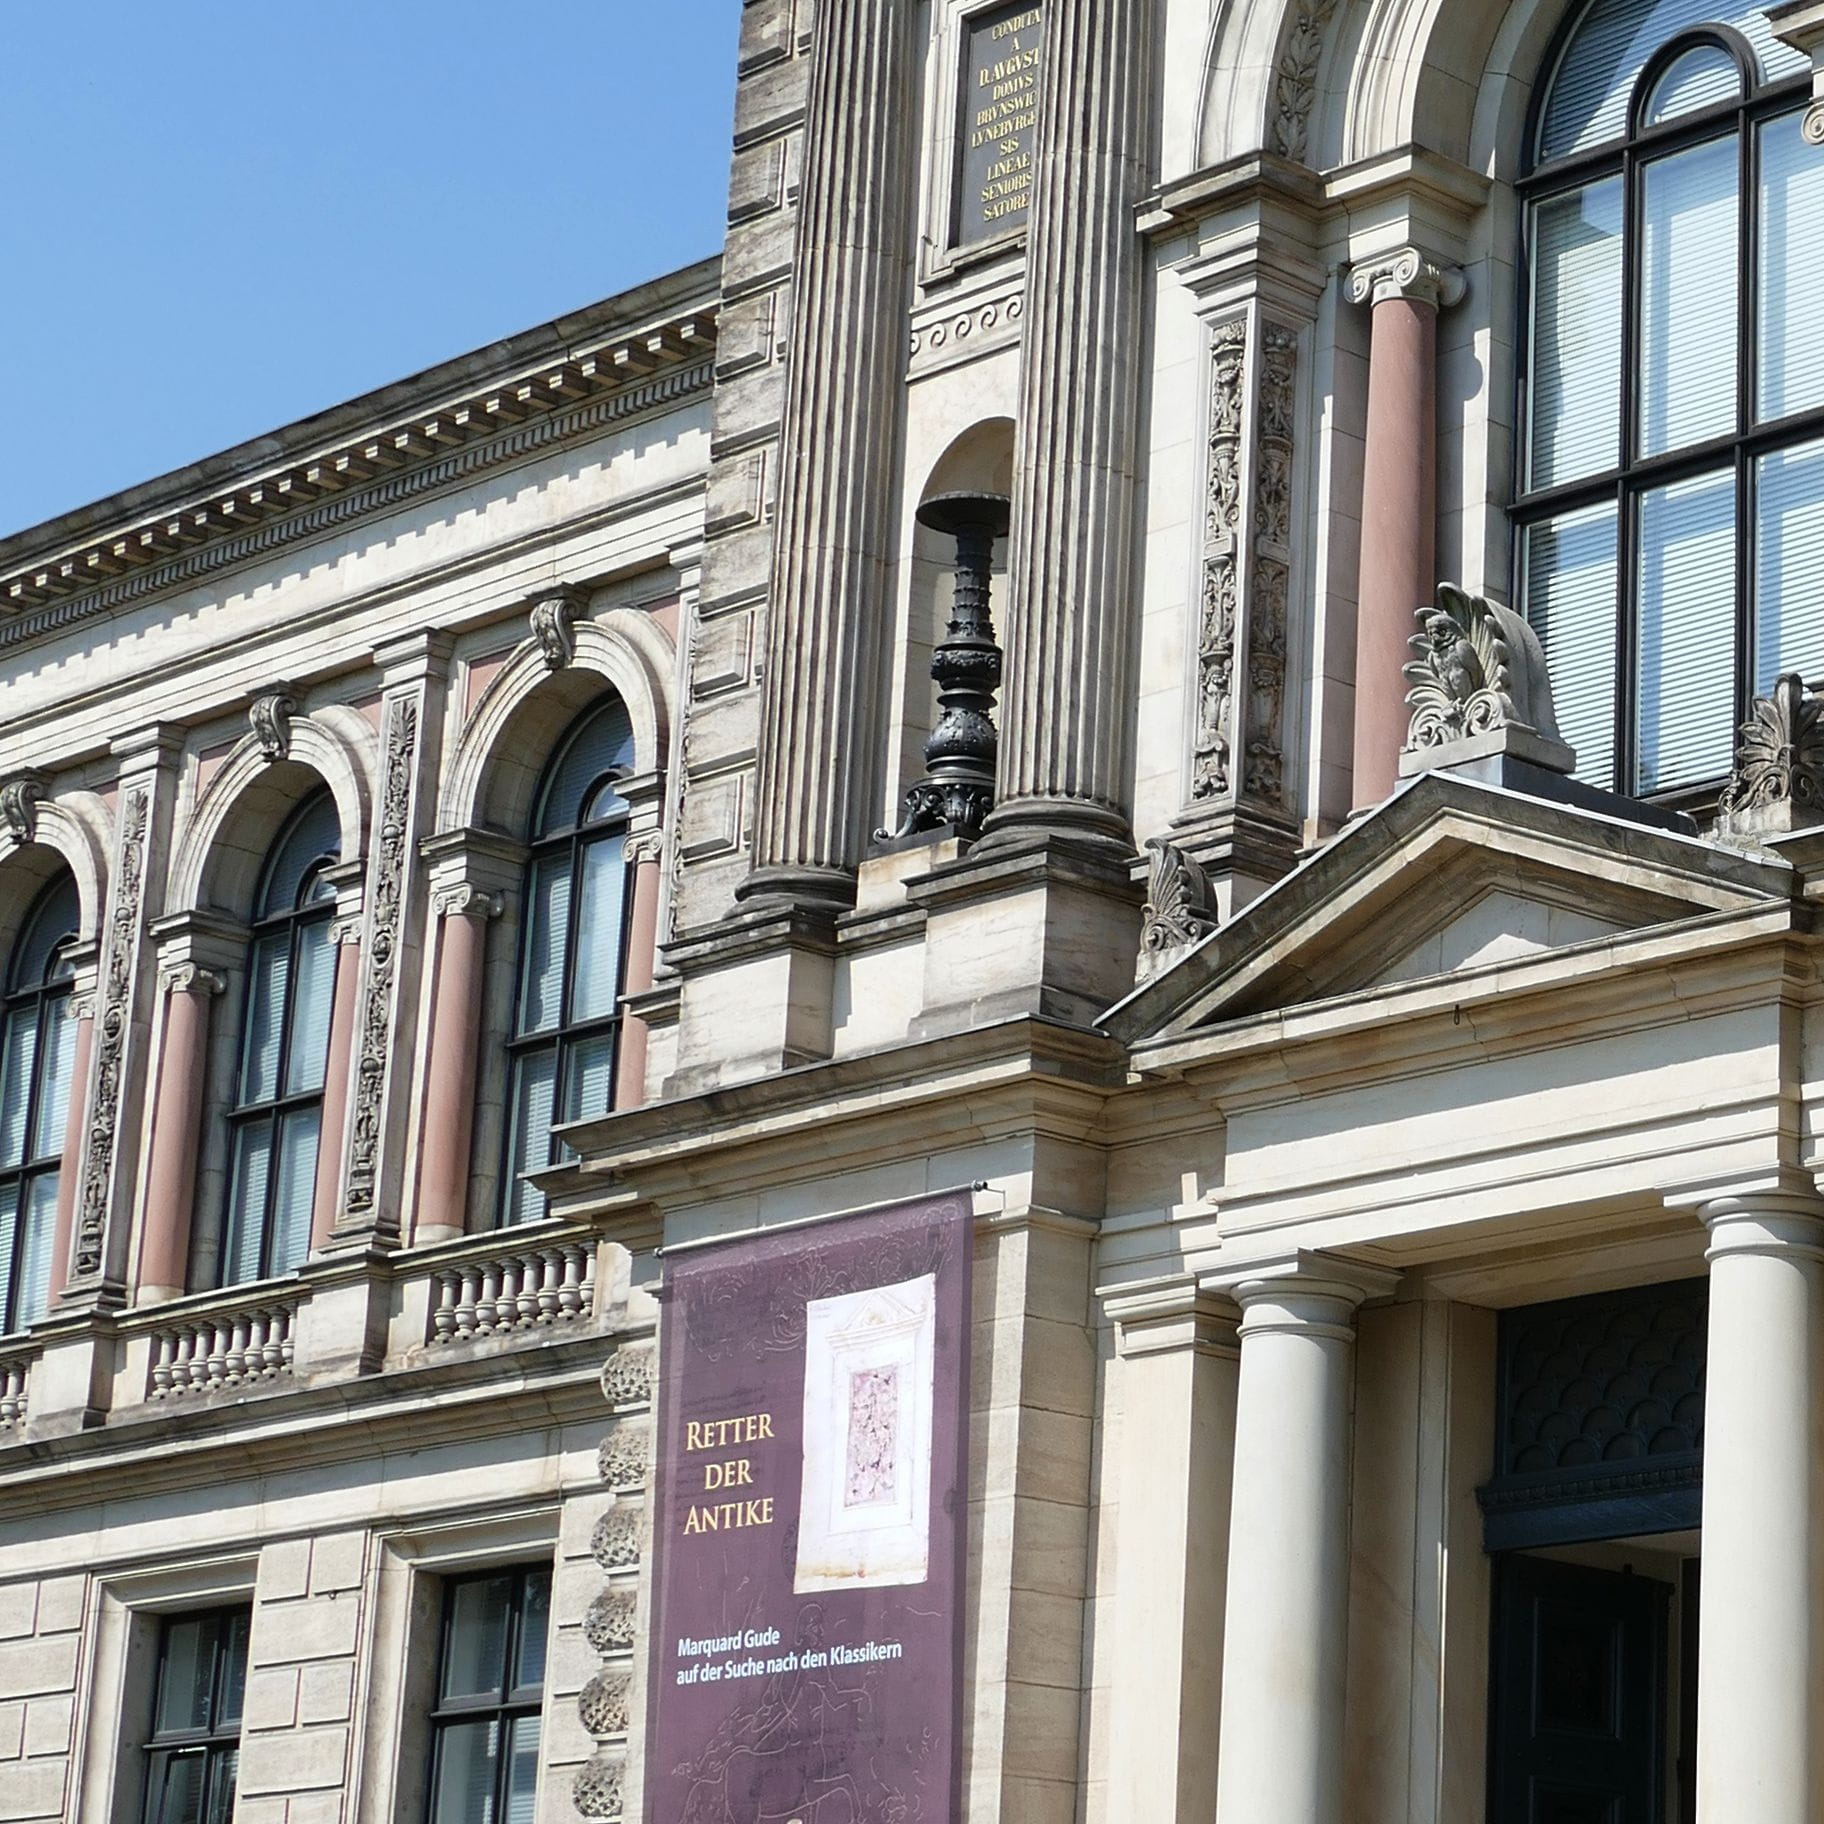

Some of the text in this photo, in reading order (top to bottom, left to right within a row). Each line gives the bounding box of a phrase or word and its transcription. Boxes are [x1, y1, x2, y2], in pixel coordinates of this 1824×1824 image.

[992, 8, 1041, 41] CONDITA
[1011, 37, 1021, 53] A
[993, 72, 1033, 101] DOMVS
[1000, 136, 1019, 156] SIS
[987, 151, 1030, 181] LINEAE
[981, 171, 1033, 203] SENIORIS
[984, 192, 1030, 222] SATORE
[686, 1413, 775, 1451] RETTER
[704, 1459, 754, 1490] DER
[682, 1497, 774, 1535] ANTIKE
[677, 1626, 780, 1658] Marquard Gude
[676, 1640, 903, 1685] auf der Suche nach den Klassikern
